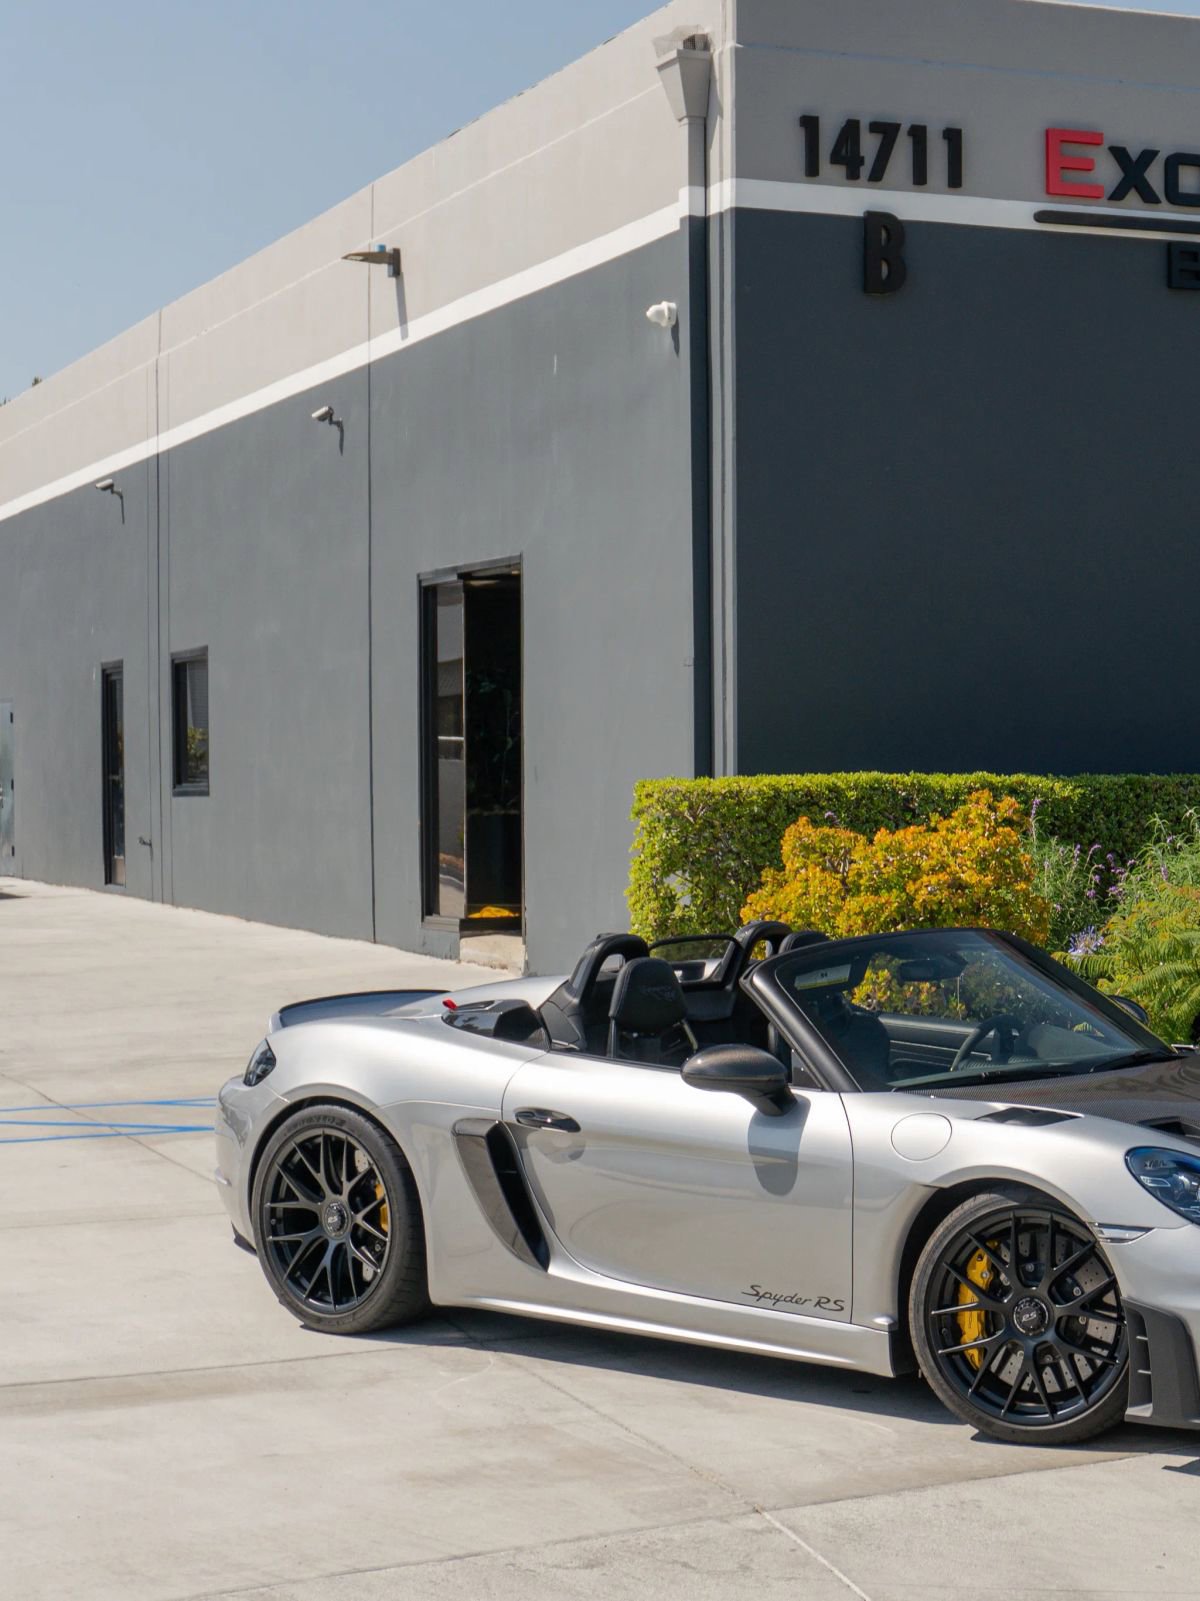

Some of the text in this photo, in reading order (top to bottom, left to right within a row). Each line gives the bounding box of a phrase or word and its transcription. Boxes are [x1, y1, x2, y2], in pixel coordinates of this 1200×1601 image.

[800, 115, 963, 188] 14711
[862, 210, 906, 296] B
[741, 1284, 845, 1312] Spyder RS
